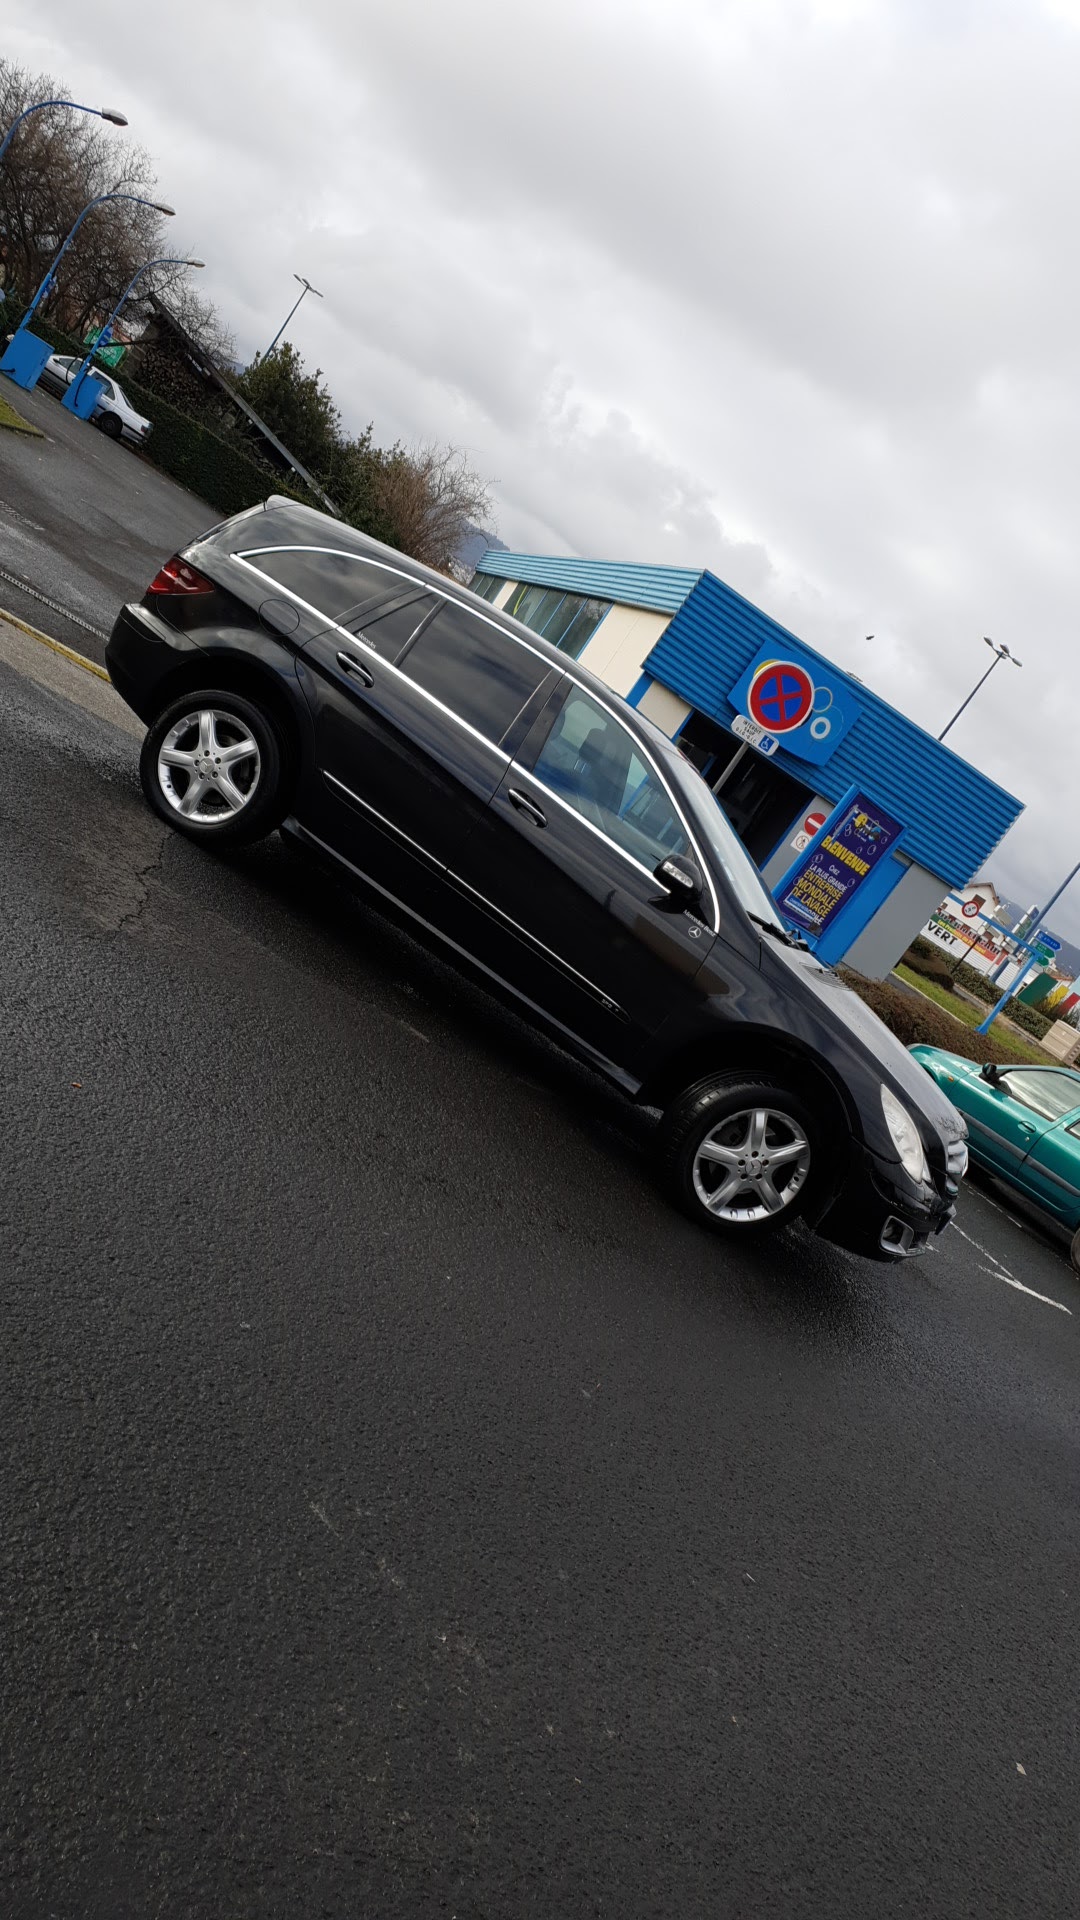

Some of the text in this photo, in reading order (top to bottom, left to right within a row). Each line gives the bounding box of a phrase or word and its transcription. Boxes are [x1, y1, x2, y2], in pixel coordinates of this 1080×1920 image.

[821, 835, 870, 876] BIENVENUE
[803, 869, 843, 900] ENTREPRISE
[809, 863, 848, 893] LA PLUS GRANDE
[797, 878, 837, 910] MONDIALE
[800, 893, 831, 918] LAVAGE
[927, 921, 958, 945] VERT
